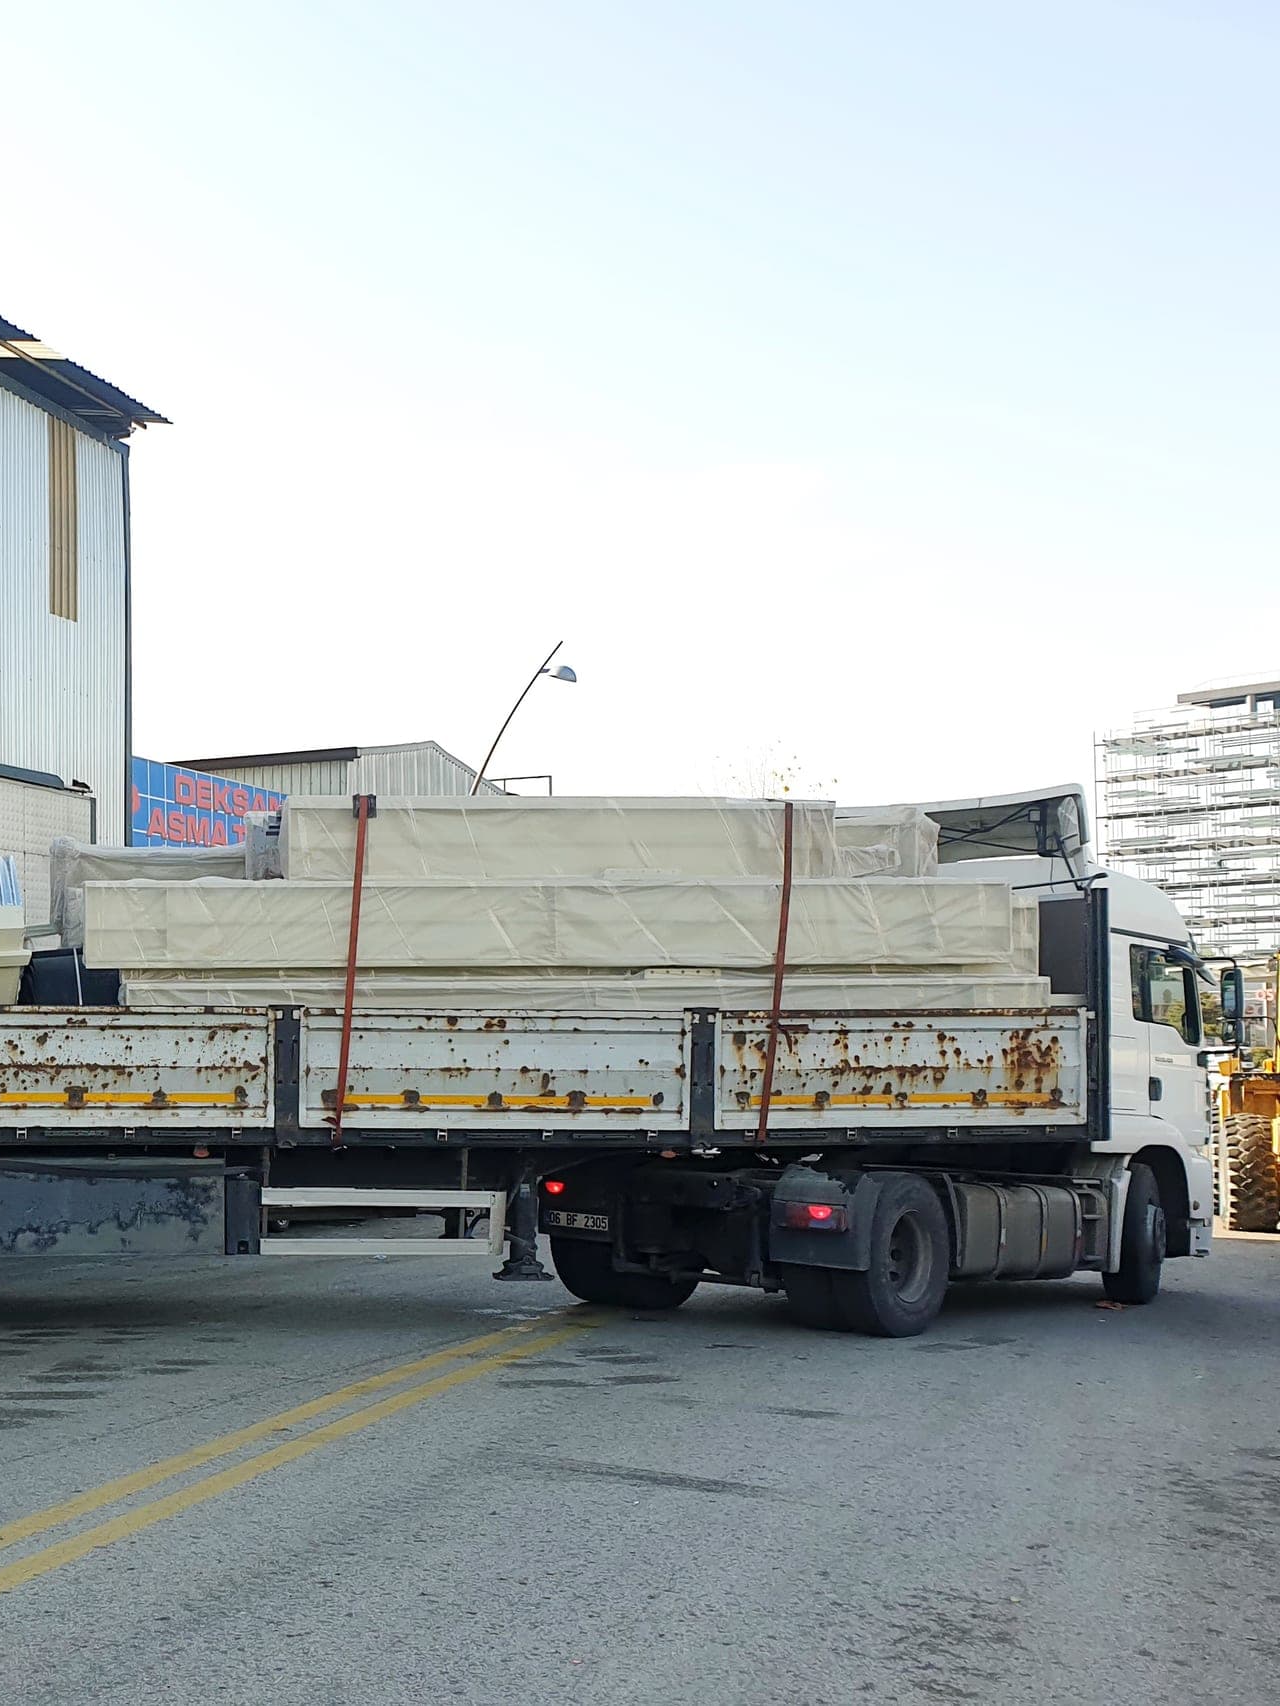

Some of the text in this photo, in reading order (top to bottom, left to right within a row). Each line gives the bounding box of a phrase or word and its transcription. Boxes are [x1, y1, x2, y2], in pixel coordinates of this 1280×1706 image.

[147, 807, 227, 848] ASMA
[549, 1211, 561, 1225] 06
[583, 1215, 607, 1230] 2305
